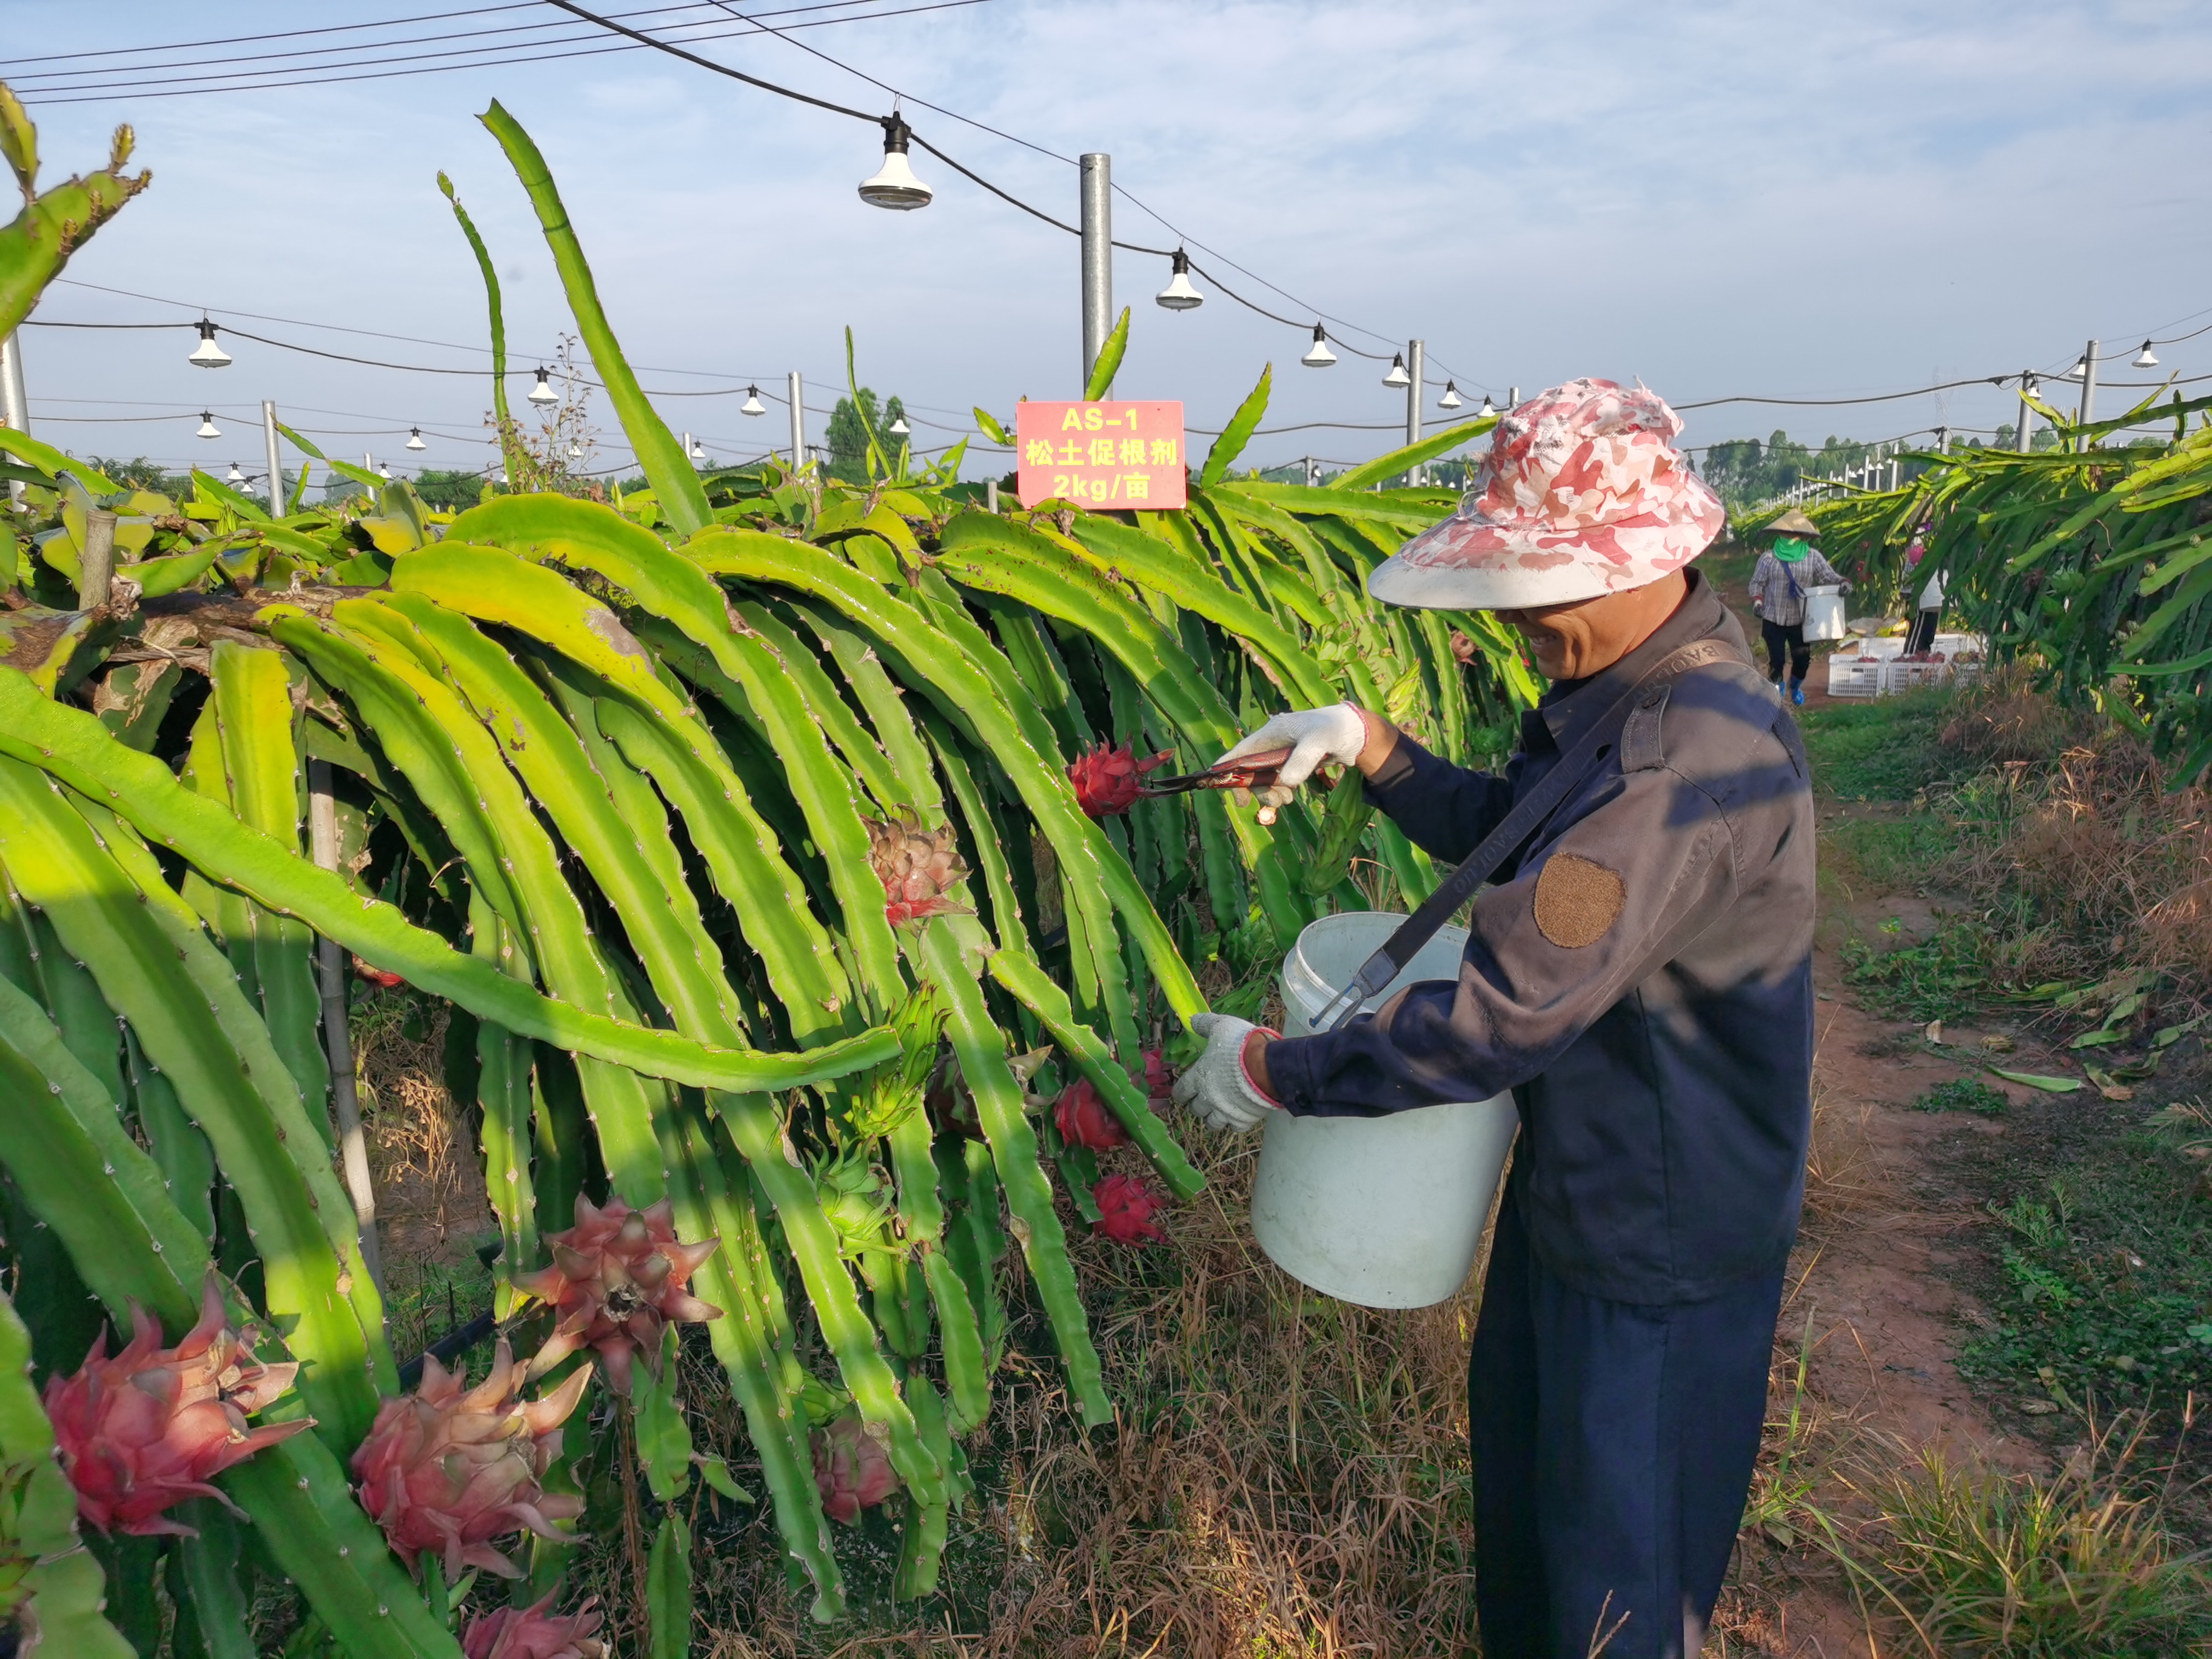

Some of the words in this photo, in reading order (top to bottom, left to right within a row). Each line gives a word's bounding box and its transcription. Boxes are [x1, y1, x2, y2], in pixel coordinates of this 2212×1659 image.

[1062, 408, 1138, 431] AS-1
[1026, 438, 1177, 466] 松土促根剂
[1053, 472, 1150, 502] 2kg/亩
